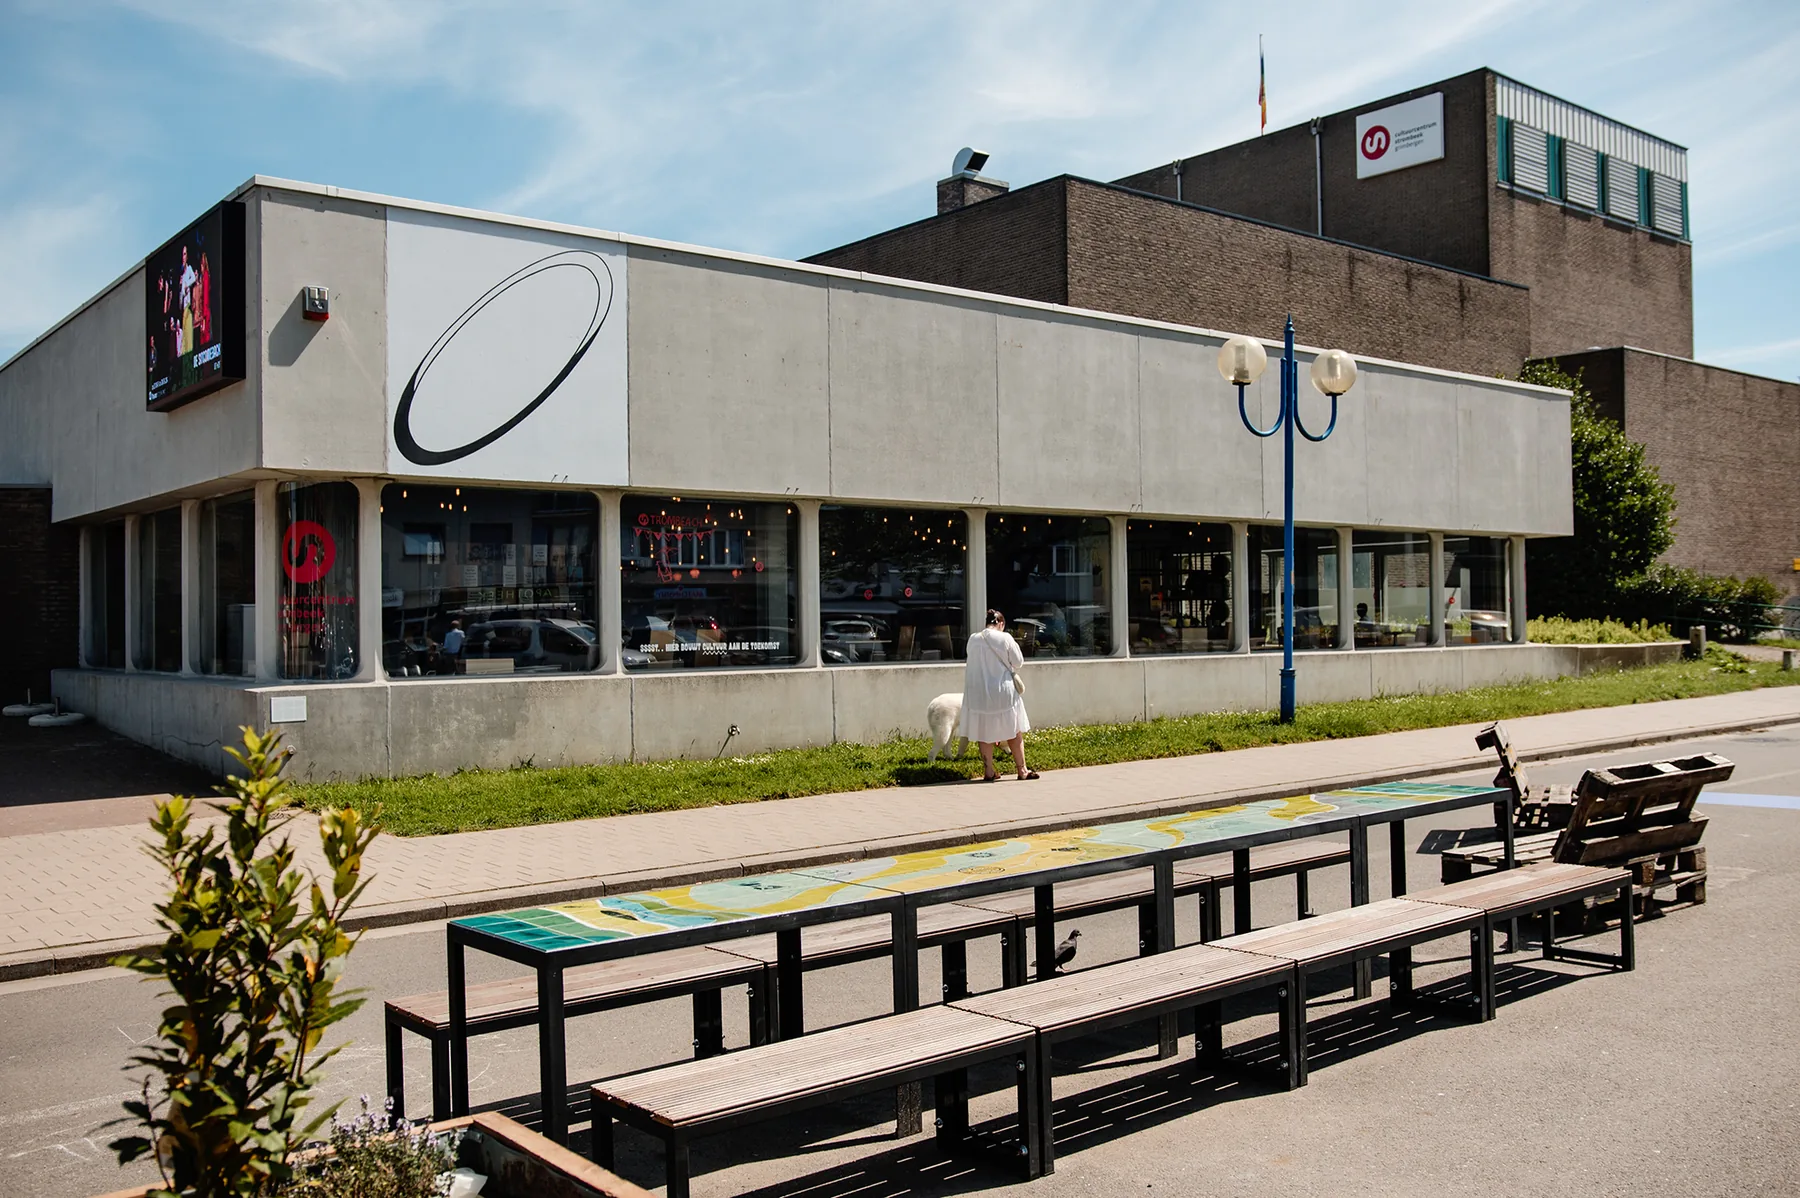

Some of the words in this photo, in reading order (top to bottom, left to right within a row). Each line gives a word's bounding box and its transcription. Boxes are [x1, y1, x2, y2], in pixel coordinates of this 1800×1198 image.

[1394, 122, 1437, 138] cultuurcentrum
[1394, 132, 1423, 144] strombeek
[702, 642, 727, 651] CULTUUR
[728, 641, 741, 650] AAN
[741, 641, 750, 650] DE
